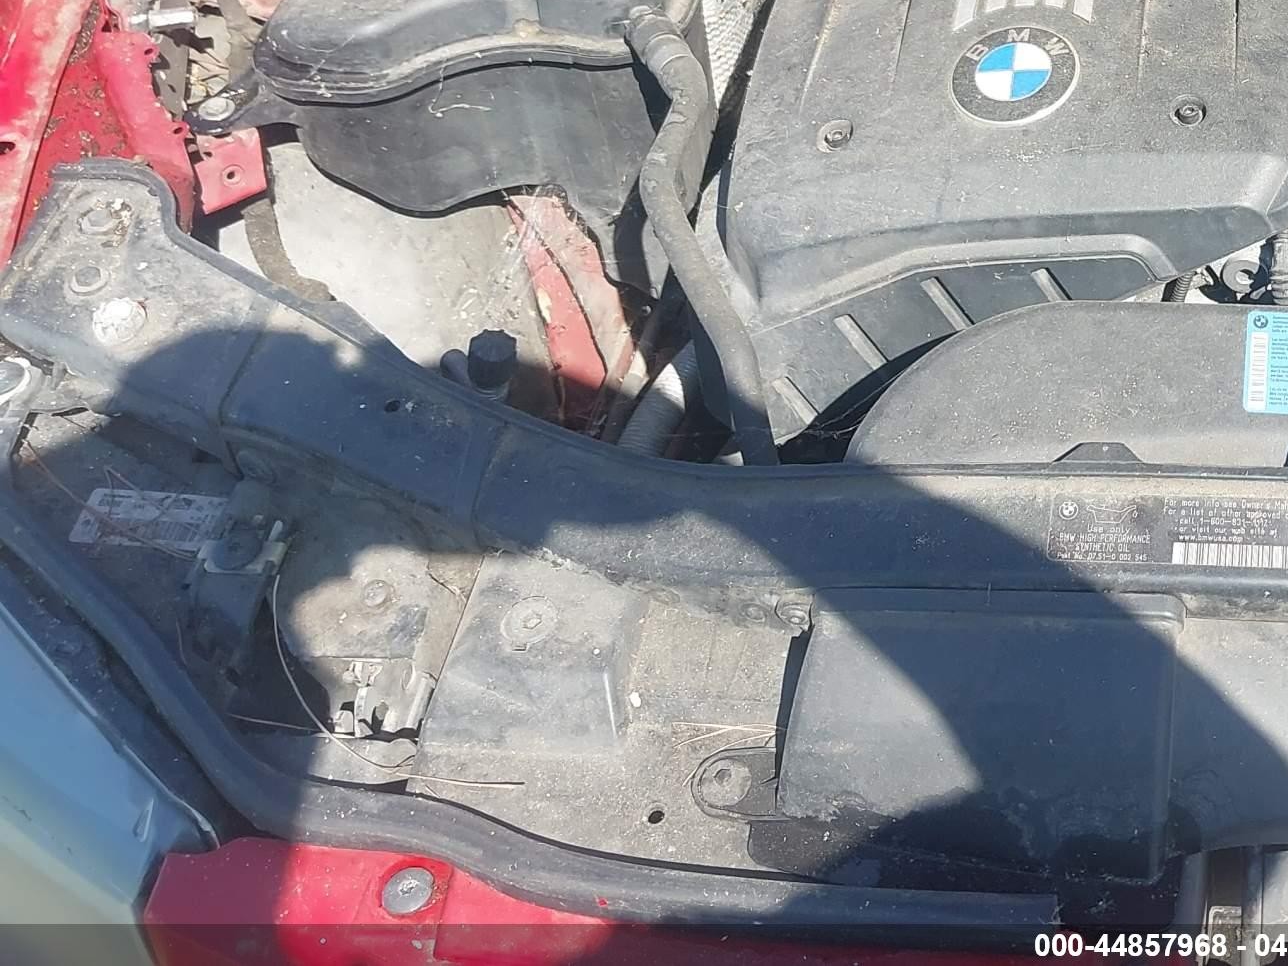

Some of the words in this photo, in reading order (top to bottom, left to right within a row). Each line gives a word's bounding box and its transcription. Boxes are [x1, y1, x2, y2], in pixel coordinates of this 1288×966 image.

[965, 28, 1072, 61] BMW
[1087, 523, 1104, 533] Use
[1109, 524, 1131, 535] only
